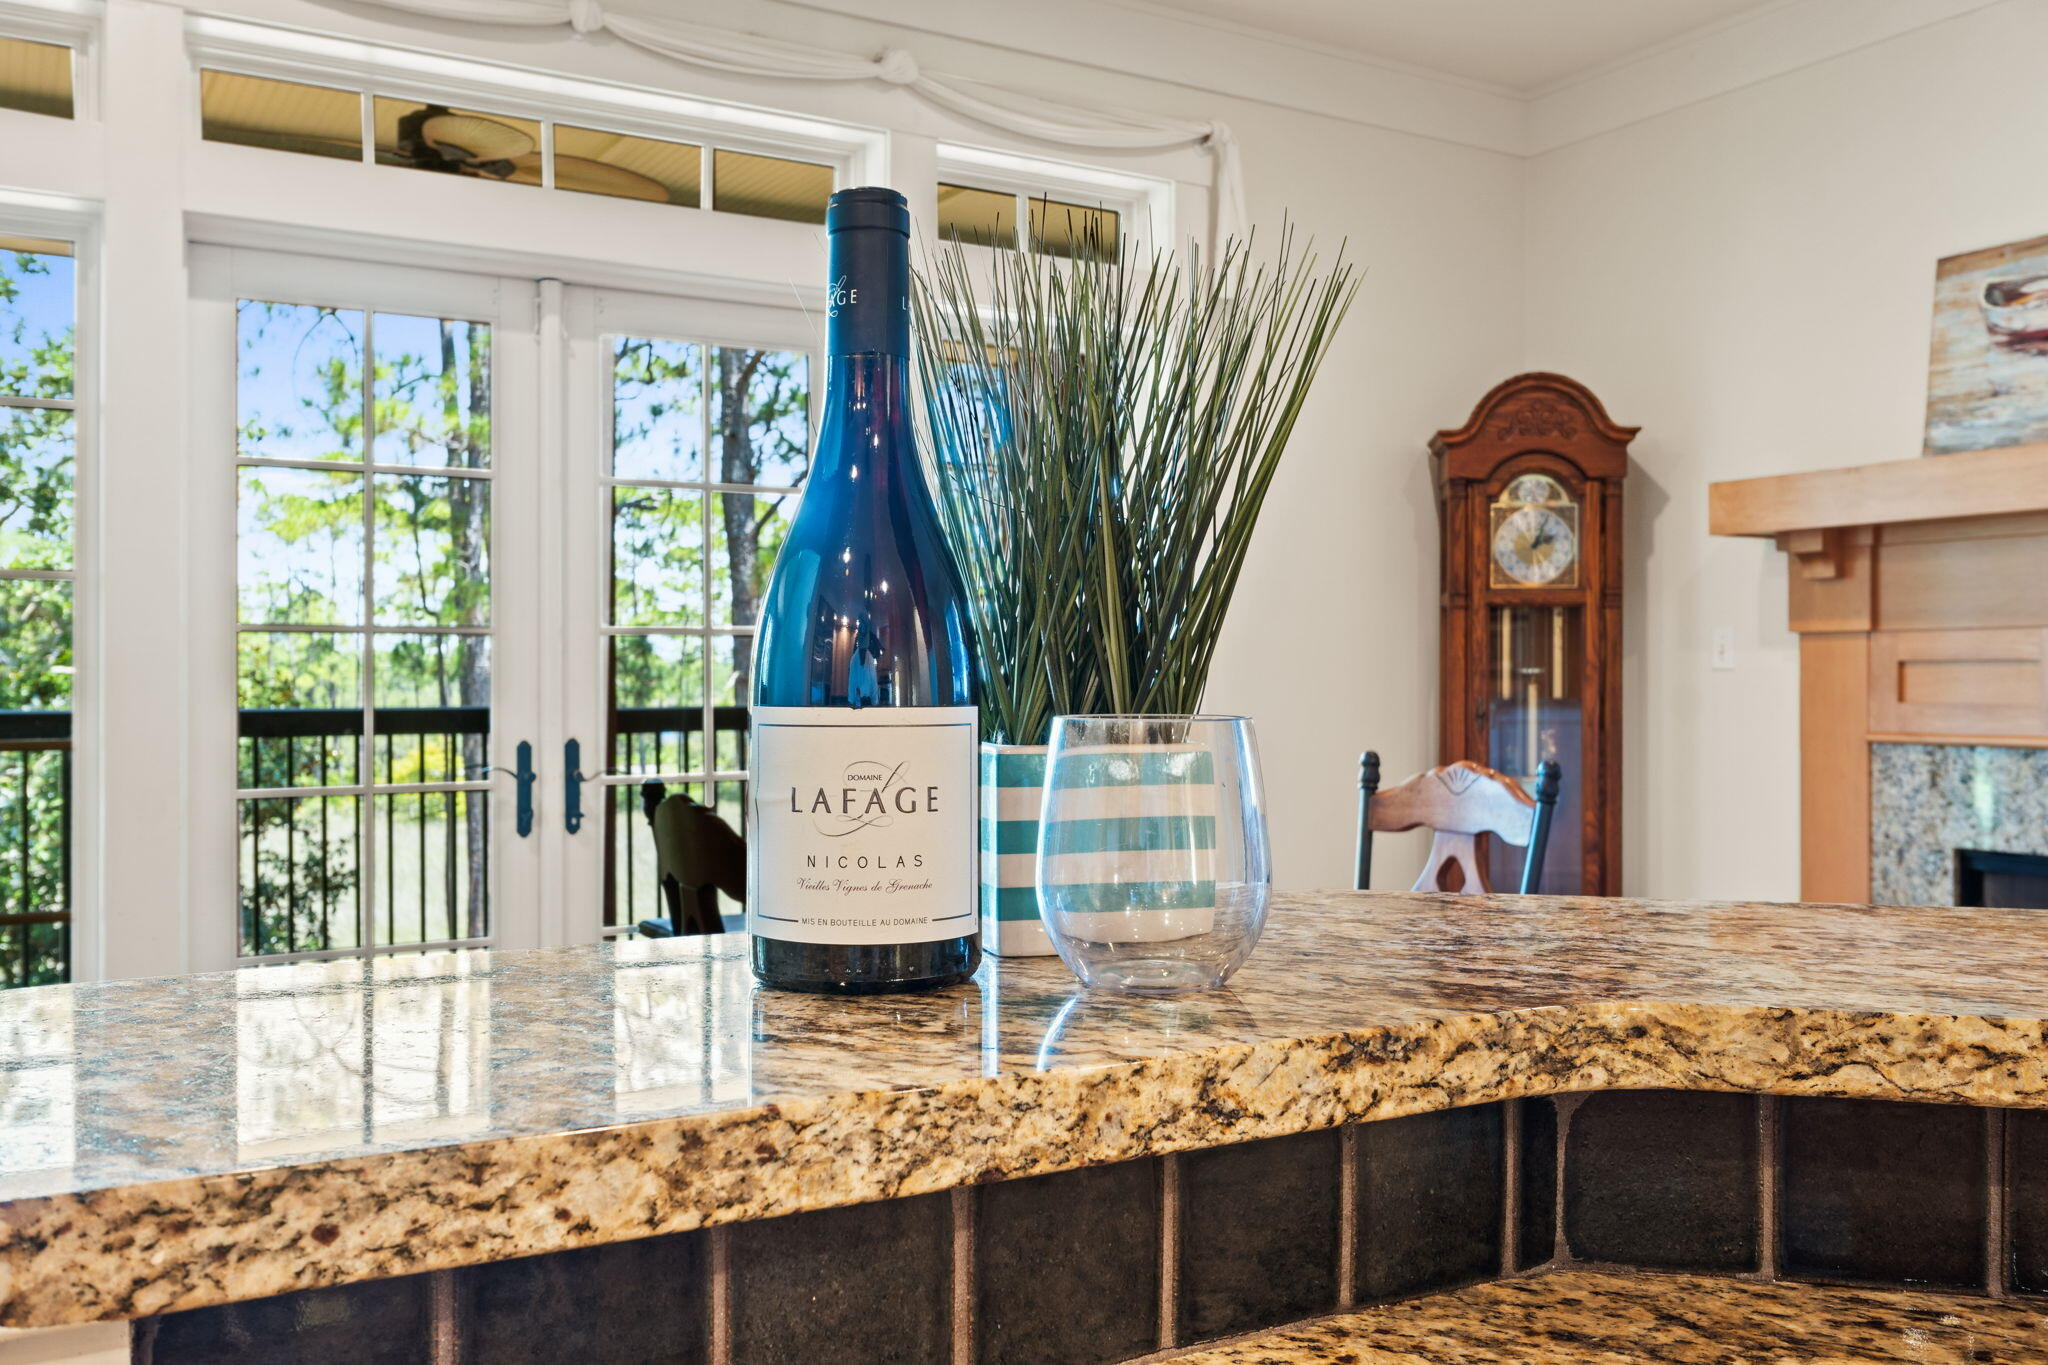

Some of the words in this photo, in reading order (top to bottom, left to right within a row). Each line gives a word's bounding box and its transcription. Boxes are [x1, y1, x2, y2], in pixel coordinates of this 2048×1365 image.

[791, 786, 939, 814] LAFAGE
[807, 854, 923, 869] NICOLAS
[797, 877, 830, 891] Vieilles
[832, 879, 868, 896] Vignes
[870, 881, 883, 892] de
[885, 878, 933, 894] Grenache
[801, 917, 815, 926] MIS
[817, 918, 828, 926] EN
[830, 919, 877, 927] BOUTEILLE
[893, 916, 929, 926] DOMAINE
